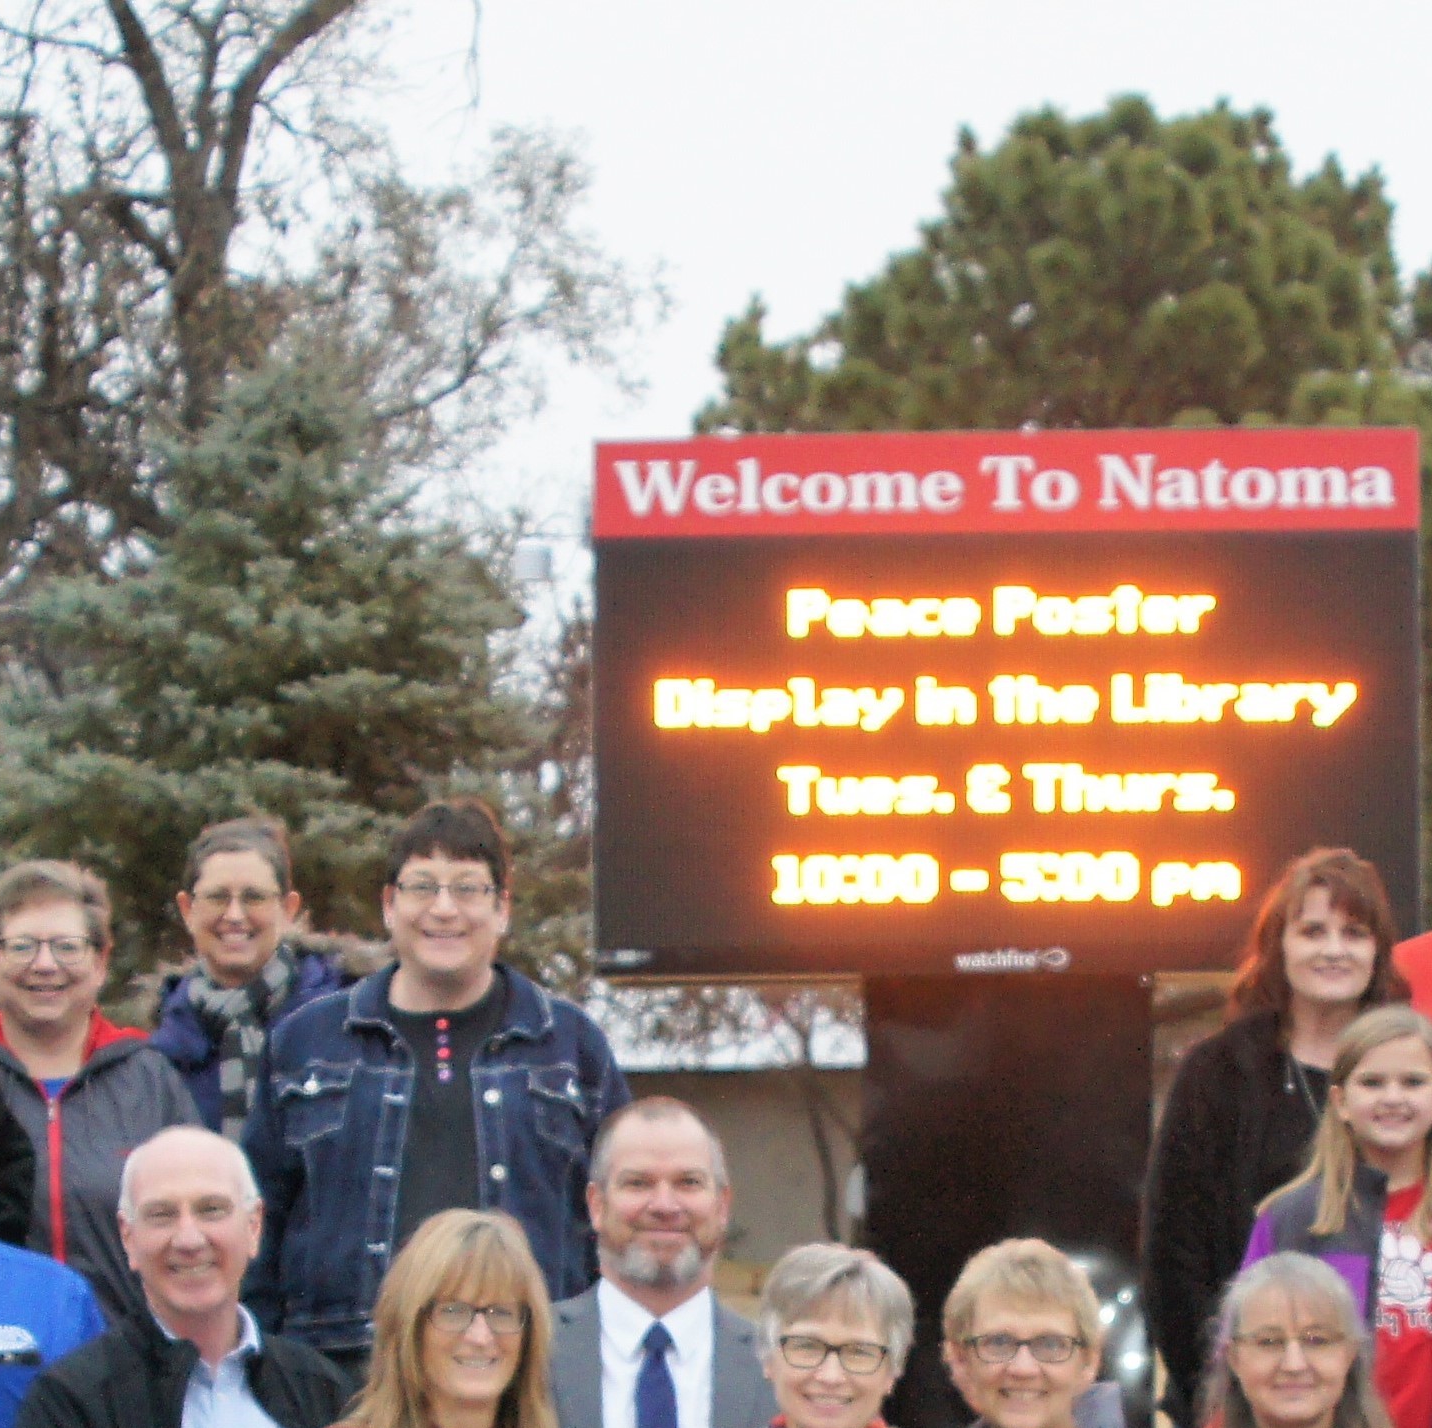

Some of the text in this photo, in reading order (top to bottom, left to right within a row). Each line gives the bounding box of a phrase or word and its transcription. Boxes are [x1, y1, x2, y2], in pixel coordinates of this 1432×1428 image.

[613, 453, 1396, 517] Welcome To Natoma
[786, 584, 1217, 639] Peace Poster
[654, 672, 1358, 732] Display in the Library
[776, 763, 1236, 816] Tues. & Thurs.
[770, 854, 940, 905] 10:00
[999, 851, 1140, 902] 5:00
[1150, 862, 1242, 907] pm
[954, 948, 1036, 971] watchfire
